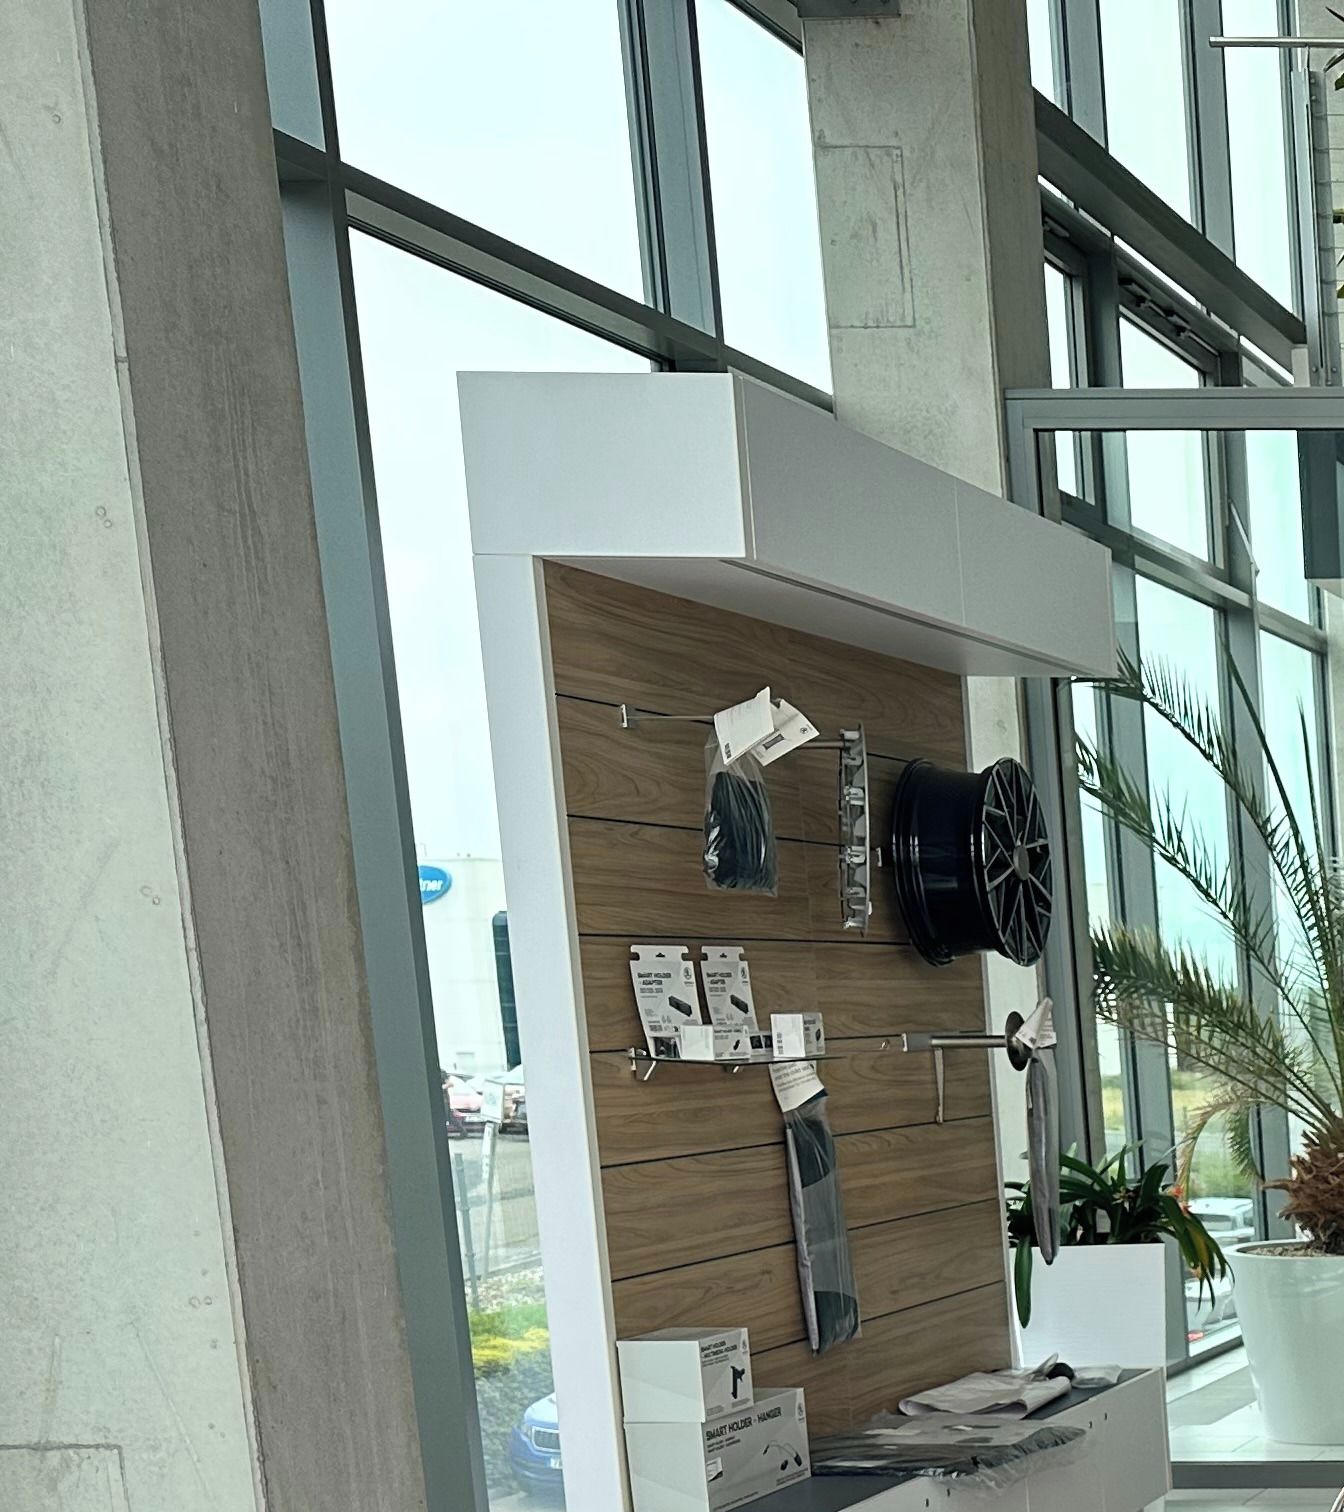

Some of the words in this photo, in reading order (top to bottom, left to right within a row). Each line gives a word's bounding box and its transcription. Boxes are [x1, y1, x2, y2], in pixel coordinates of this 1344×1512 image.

[706, 1424, 728, 1441] SMART
[728, 1416, 752, 1433] HOLDER
[757, 1406, 782, 1423] HANGER
